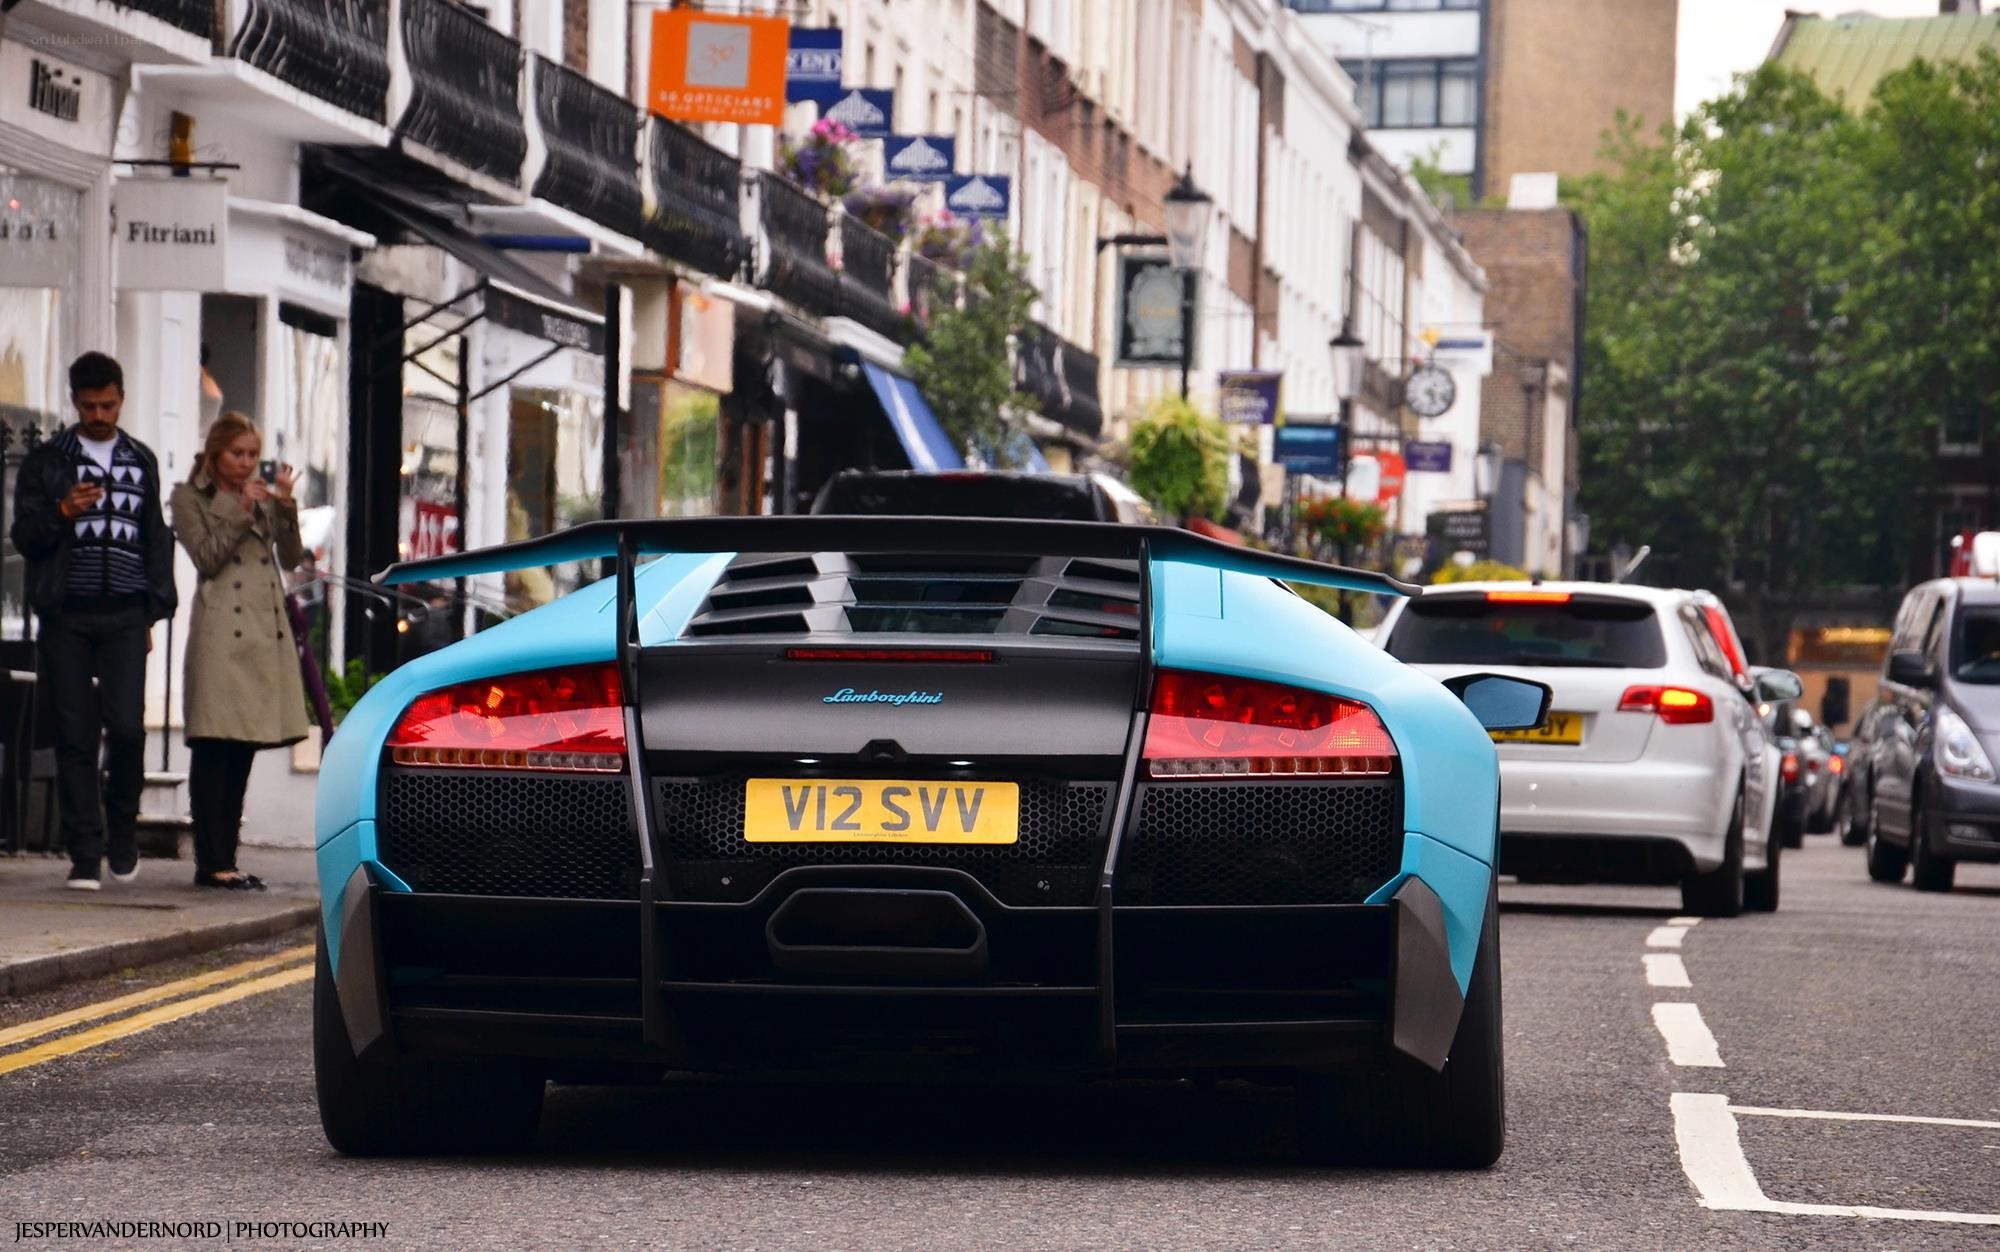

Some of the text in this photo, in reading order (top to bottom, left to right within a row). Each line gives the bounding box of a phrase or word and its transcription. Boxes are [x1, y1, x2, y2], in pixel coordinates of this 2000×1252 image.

[128, 221, 216, 244] Fitriani
[823, 688, 943, 706] Lamborghini
[781, 785, 985, 833] V12 SVV
